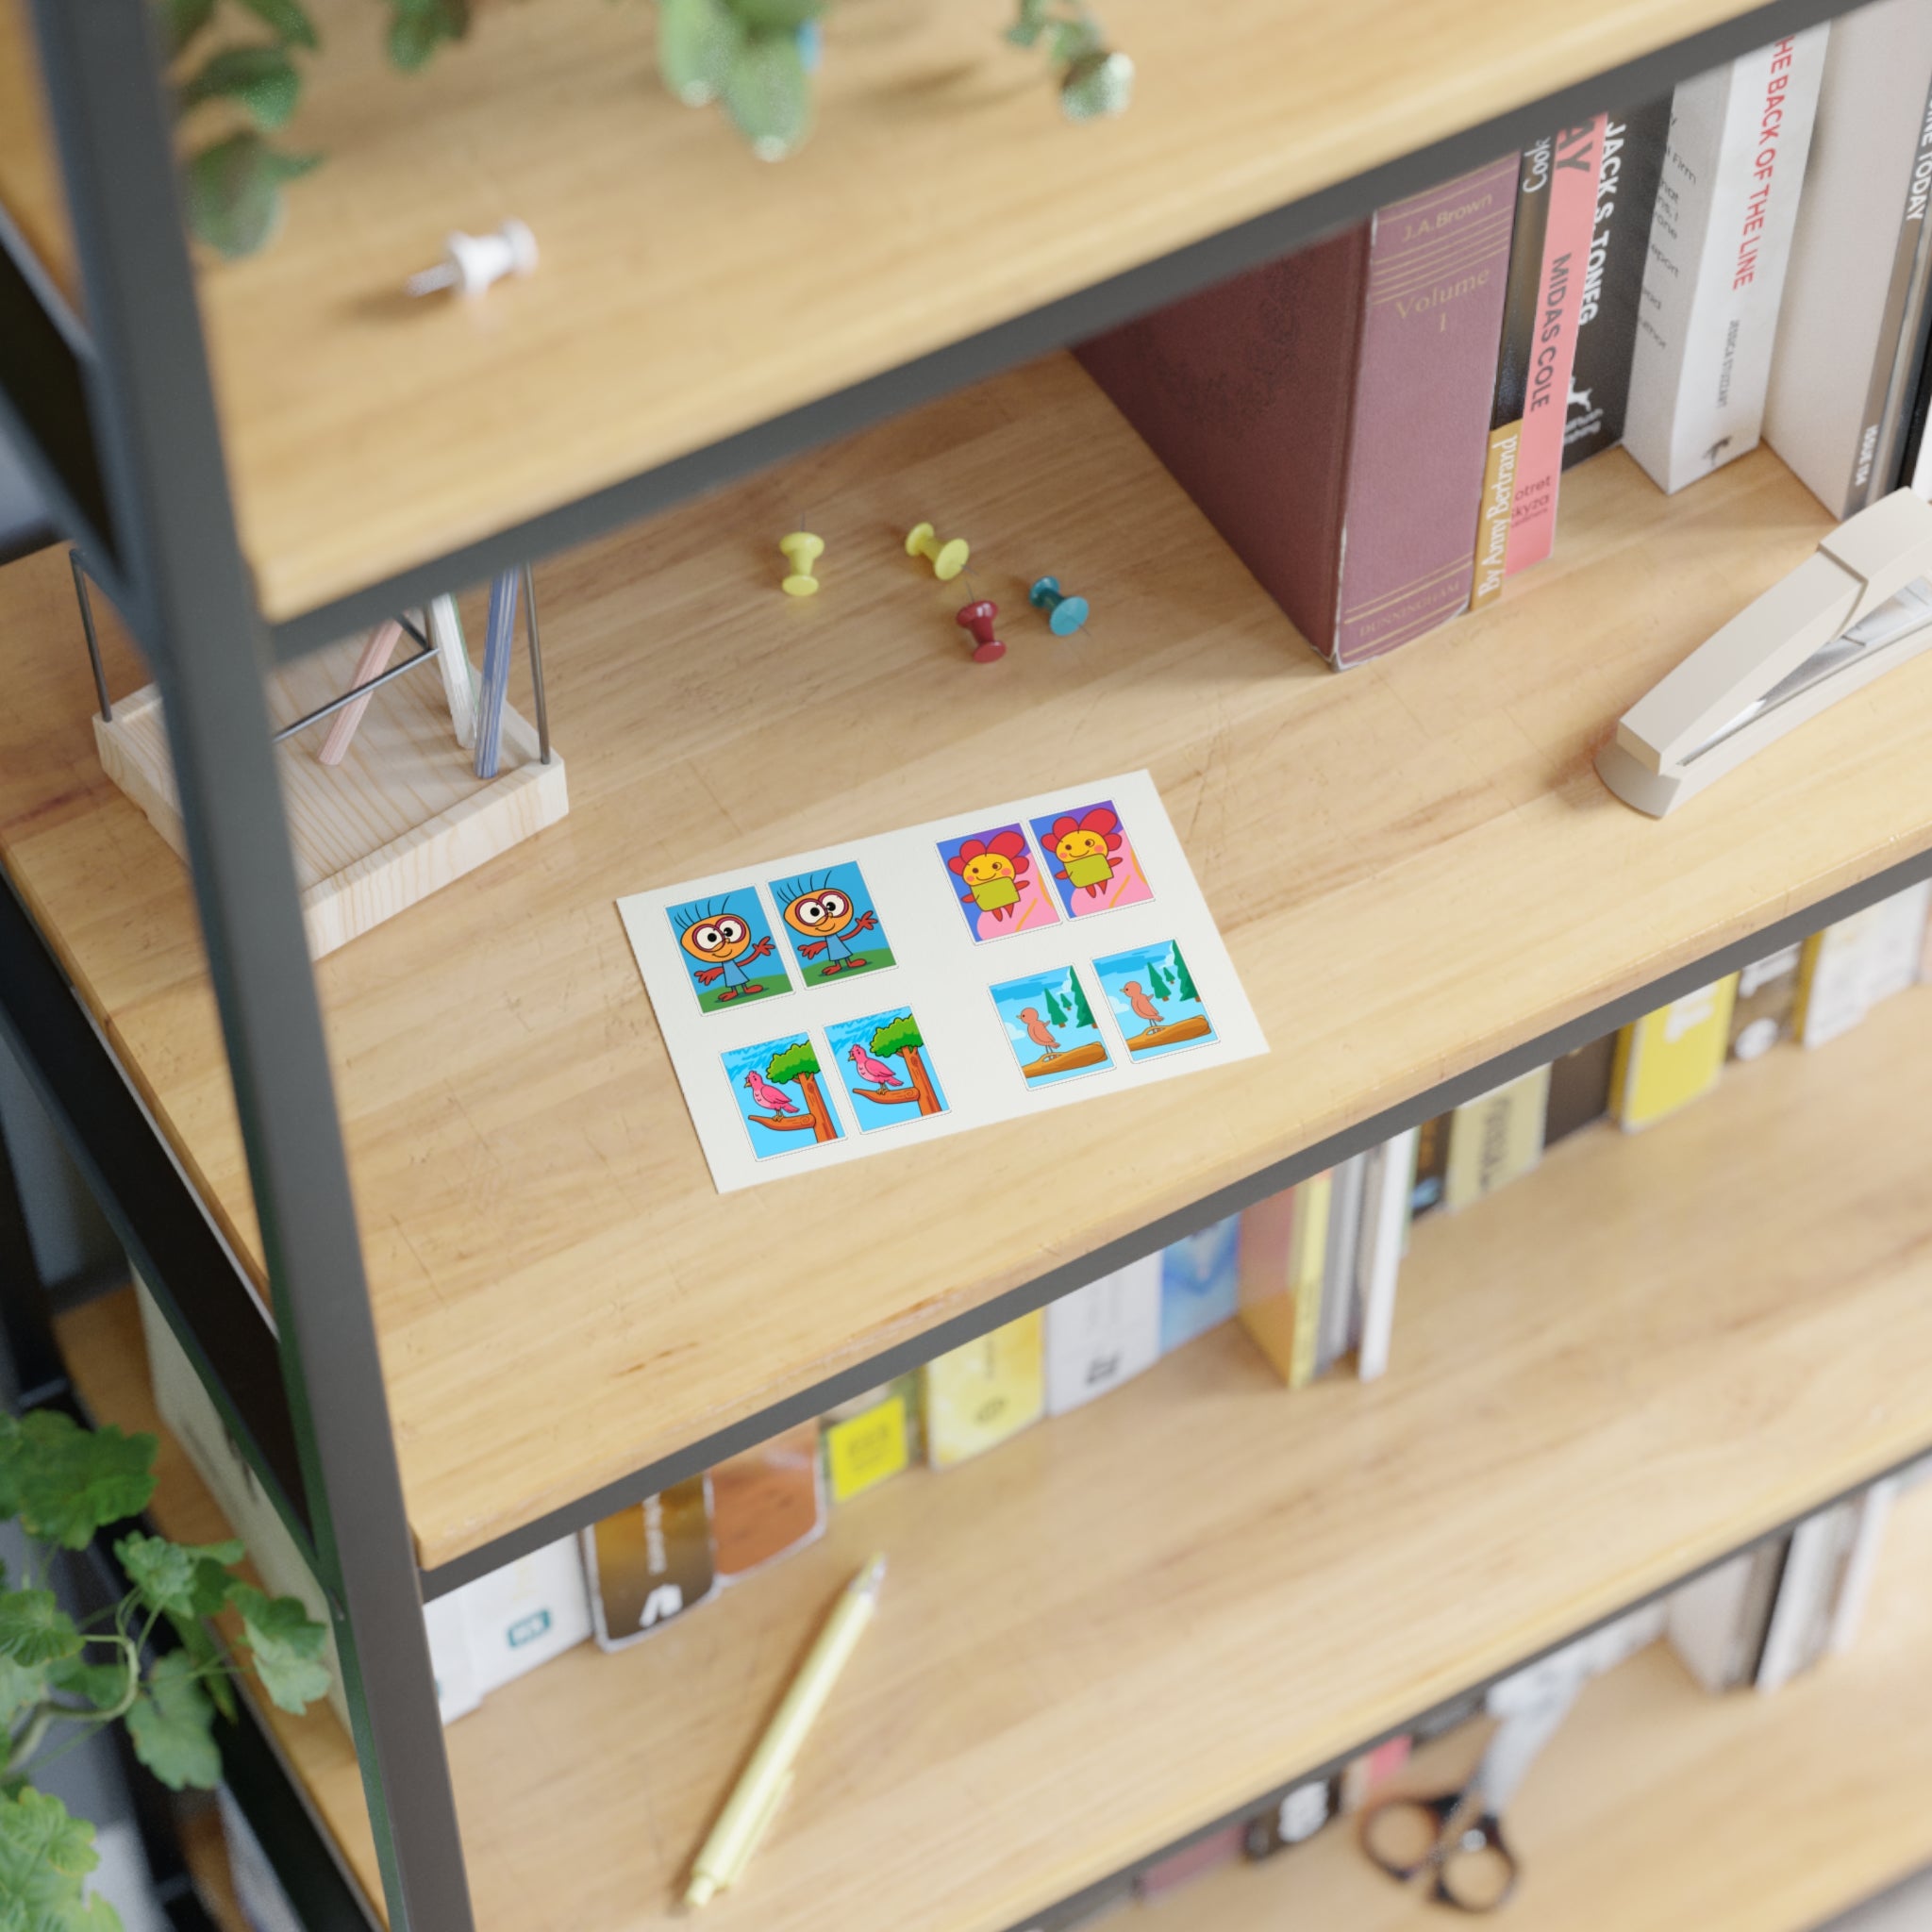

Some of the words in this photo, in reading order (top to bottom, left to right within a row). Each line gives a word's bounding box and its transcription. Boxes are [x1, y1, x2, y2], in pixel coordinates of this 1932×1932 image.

[1759, 75, 1789, 145] BACK
[1522, 136, 1552, 193] Cook
[1597, 122, 1626, 200] JACK
[1754, 148, 1776, 180] OF
[1742, 183, 1771, 236] THE
[1732, 236, 1760, 291] LINE
[1395, 270, 1490, 319] Volume
[1541, 253, 1572, 342] MIDAS
[1530, 345, 1557, 412] COLE
[1486, 434, 1518, 521] Bertrand
[1481, 518, 1511, 566] Anny
[1477, 569, 1505, 596] By
